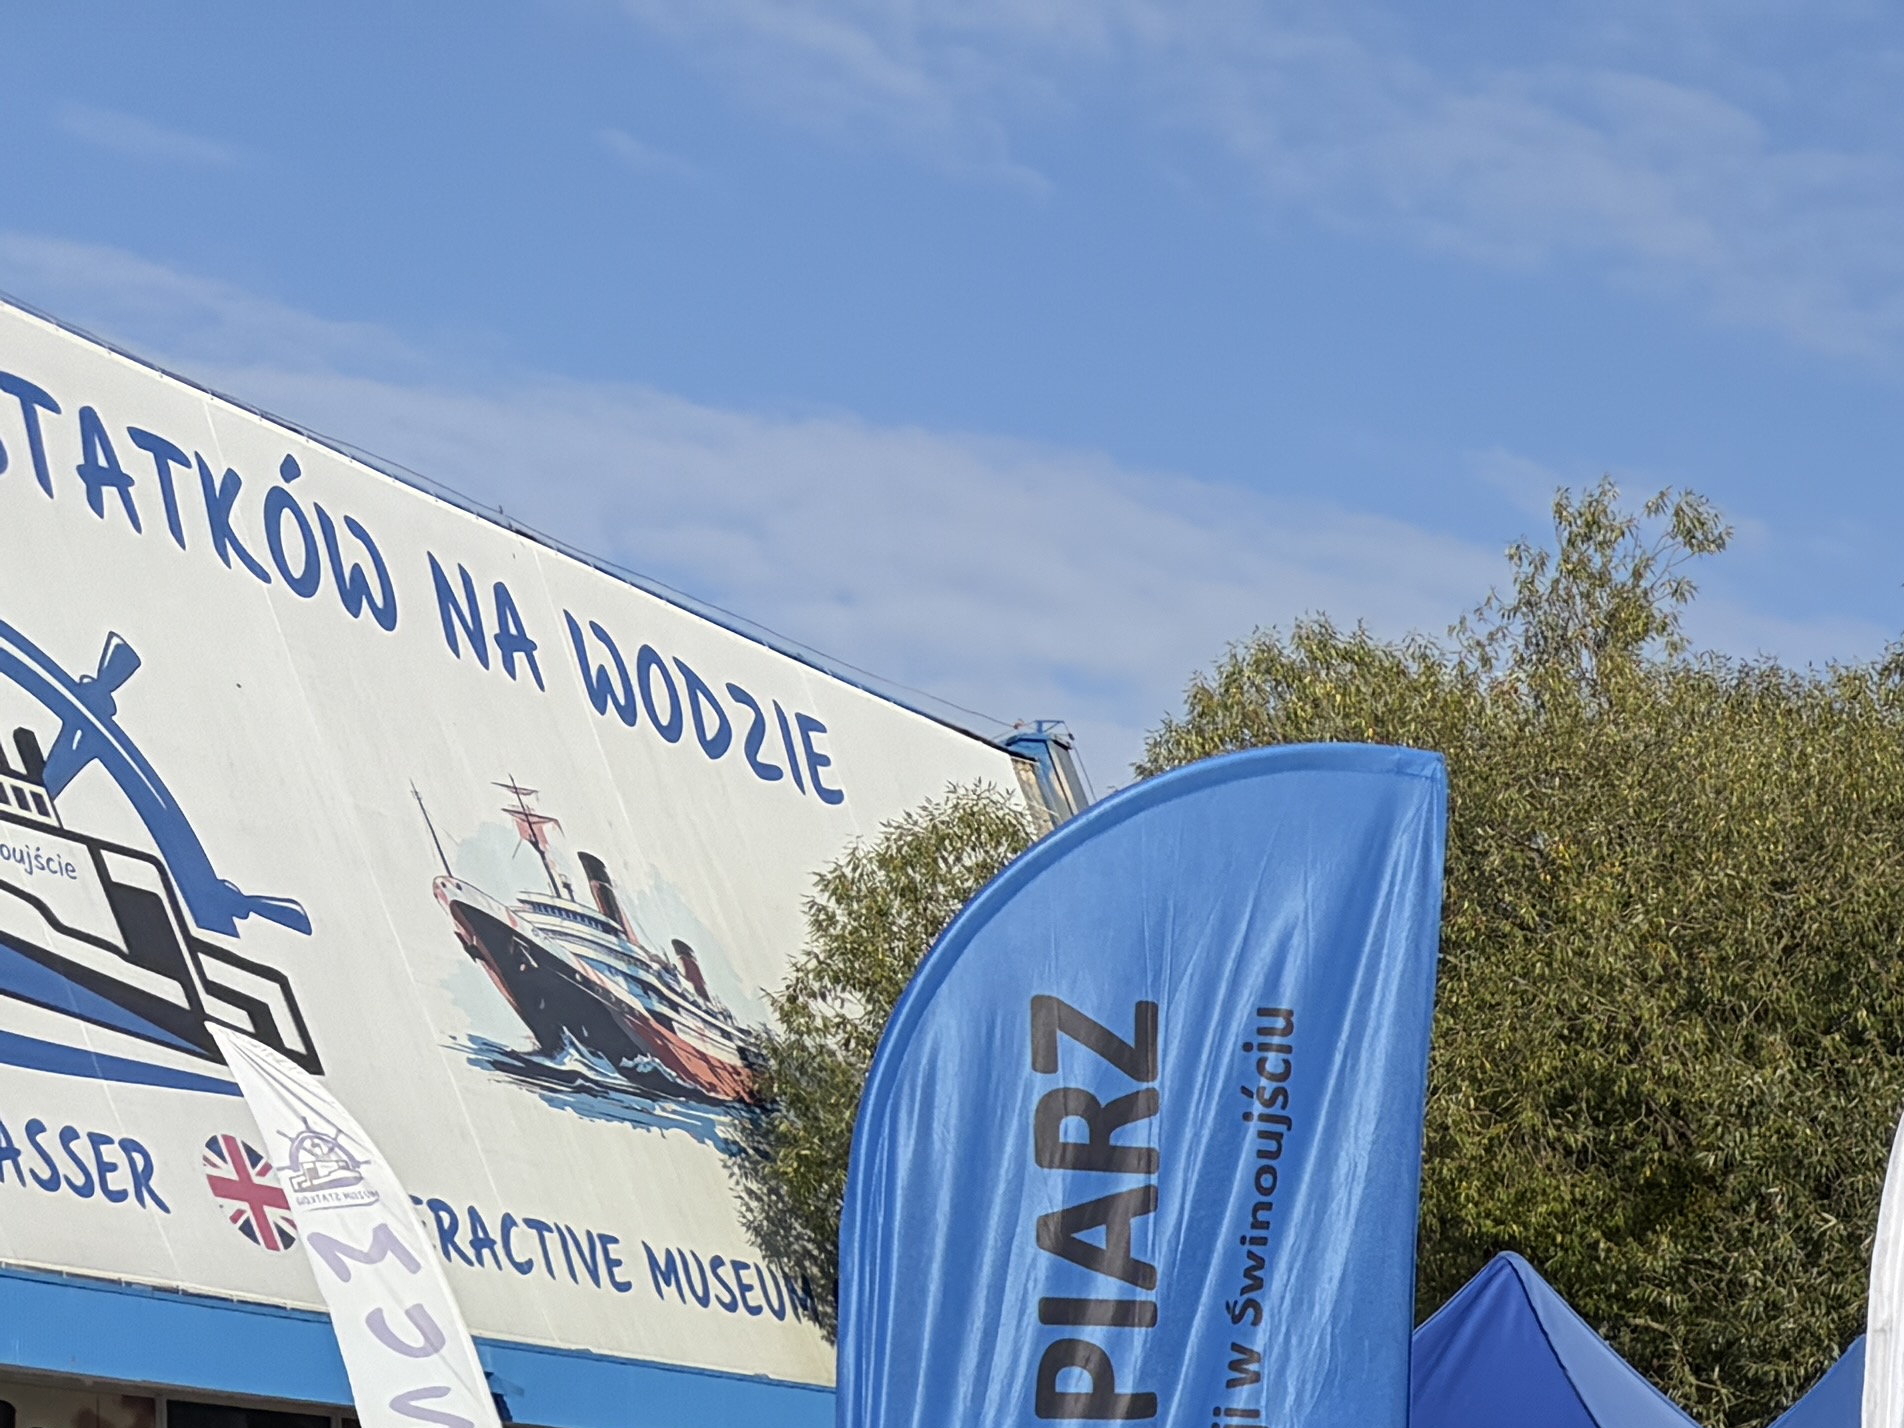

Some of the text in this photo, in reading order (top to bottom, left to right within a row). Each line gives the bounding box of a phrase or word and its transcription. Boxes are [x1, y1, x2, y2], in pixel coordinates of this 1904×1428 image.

[0, 370, 846, 804] TATKÓW NA WODZIE
[409, 1194, 633, 1293] RACTIVE
[1223, 1005, 1297, 1326] Świnoujściu
[1223, 1341, 1262, 1387] w
